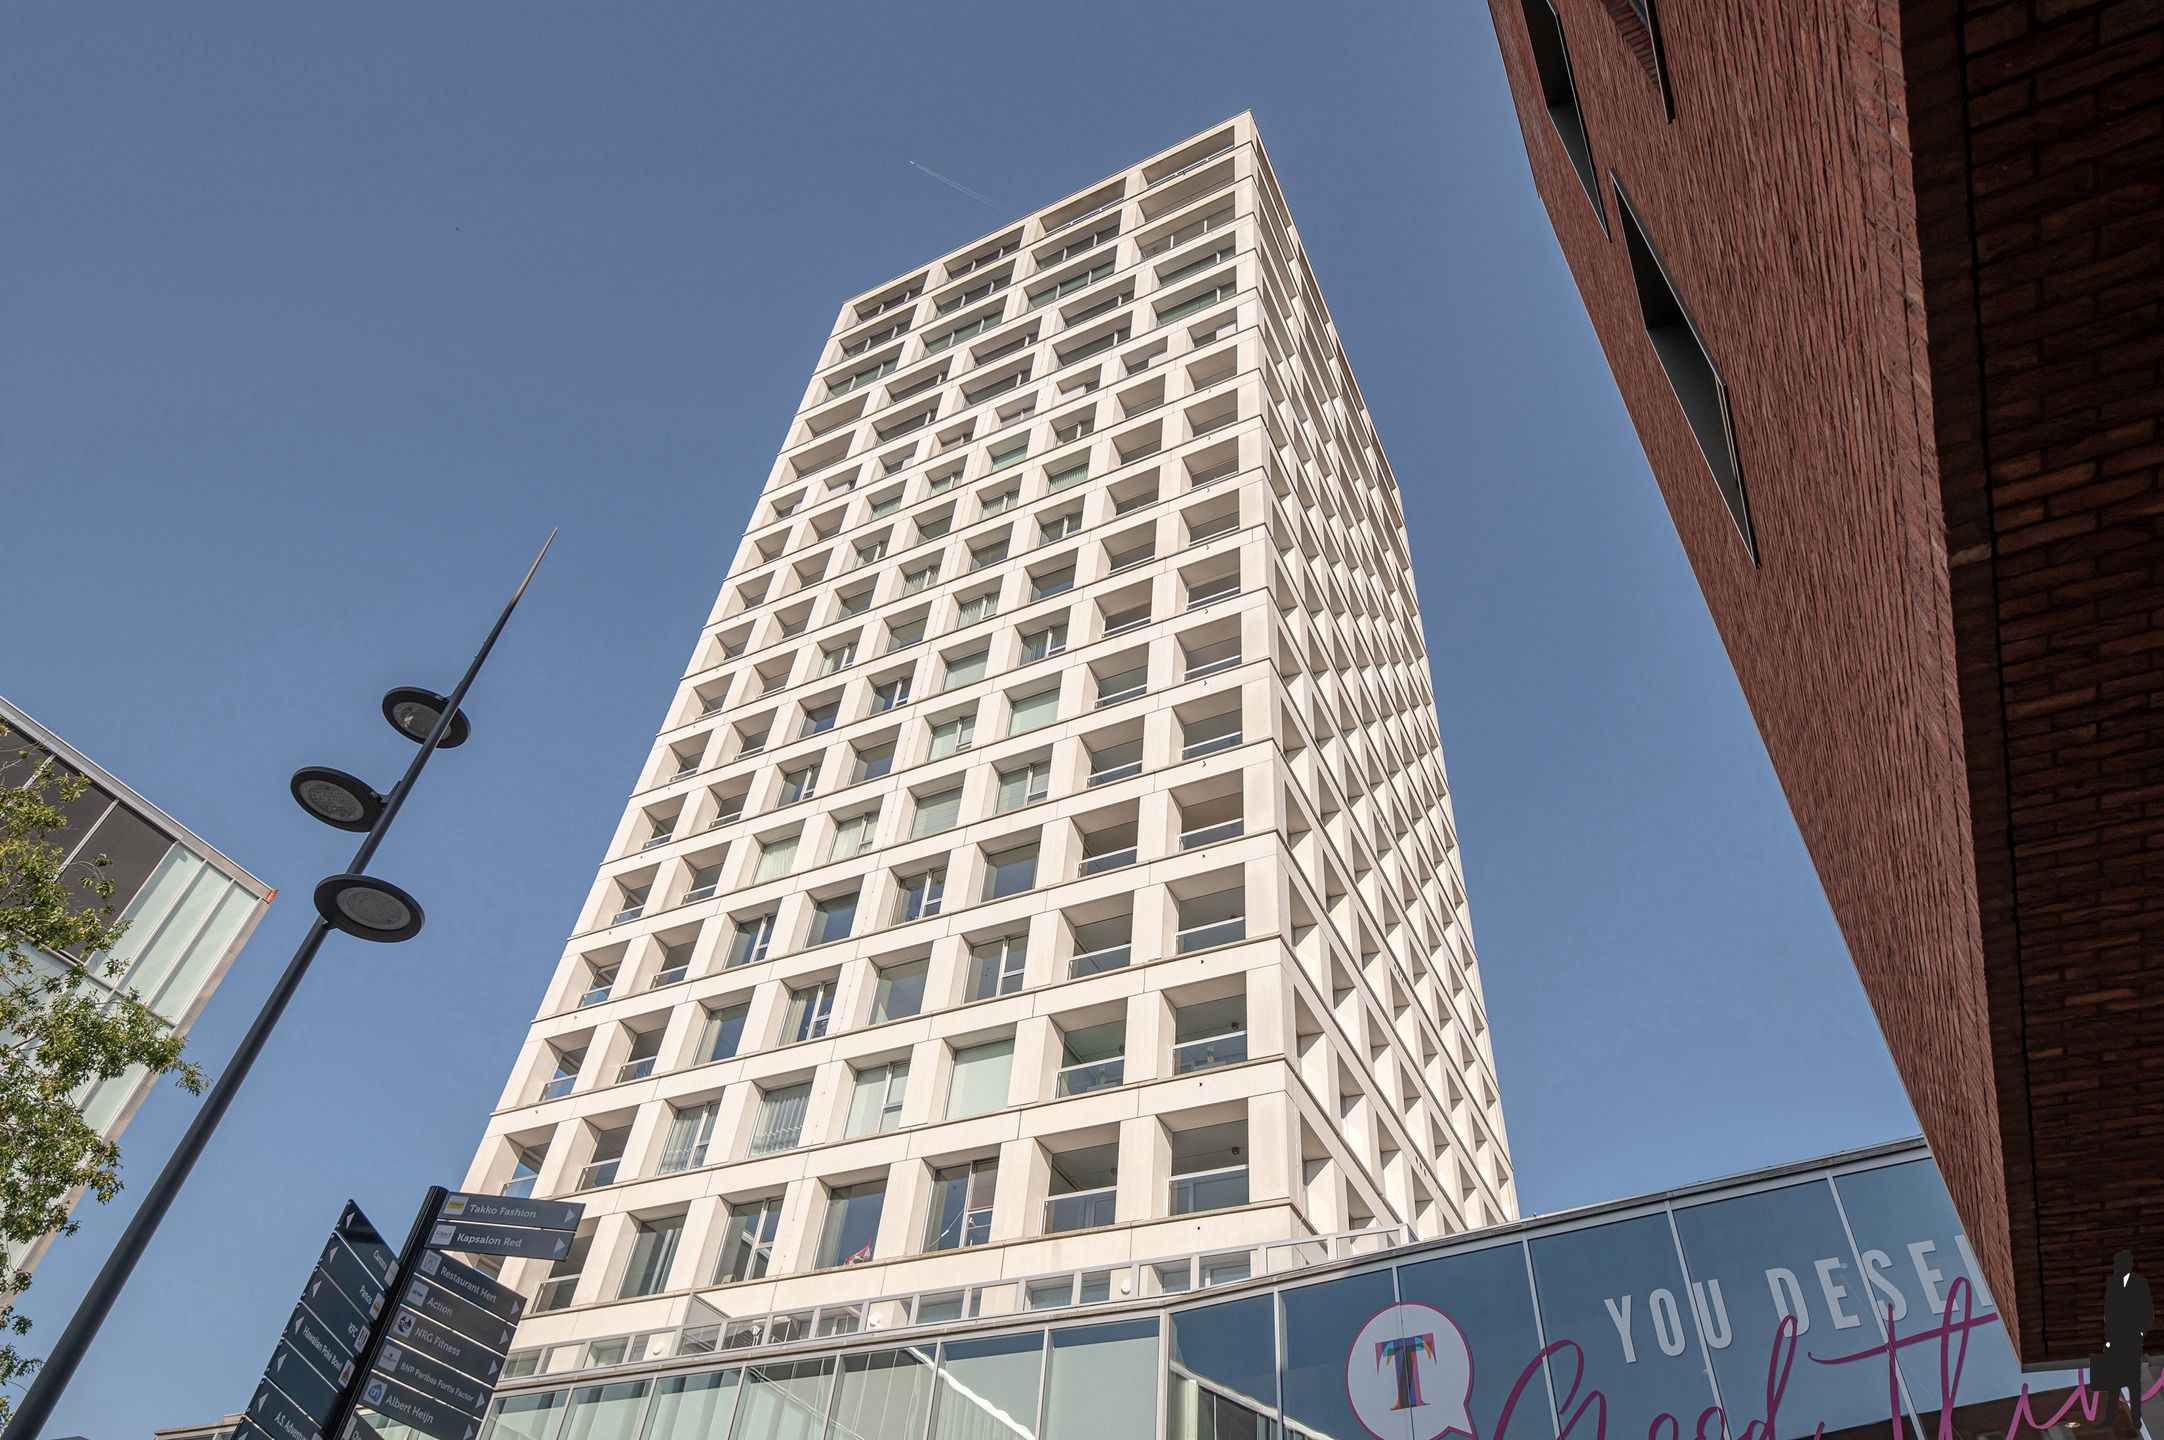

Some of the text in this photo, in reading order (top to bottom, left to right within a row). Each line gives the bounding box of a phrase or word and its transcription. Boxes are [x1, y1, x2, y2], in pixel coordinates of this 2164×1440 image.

[470, 1204, 498, 1215] Takko
[499, 1207, 537, 1219] Fashion
[456, 1233, 501, 1247] Kapsalon
[503, 1237, 522, 1248] Red
[440, 1266, 497, 1303] Restaurant Hert
[427, 1297, 453, 1316] Action
[1603, 1278, 1733, 1364] YOU
[347, 1322, 359, 1338] KFC
[415, 1327, 461, 1356] NRG Fitness
[303, 1325, 323, 1351] Hawaiian
[331, 1354, 343, 1371] Bowl
[400, 1362, 474, 1402] BNP Paribas Fortis Factor
[1375, 1332, 1437, 1411] T
[385, 1395, 434, 1424] Albert Heijn
